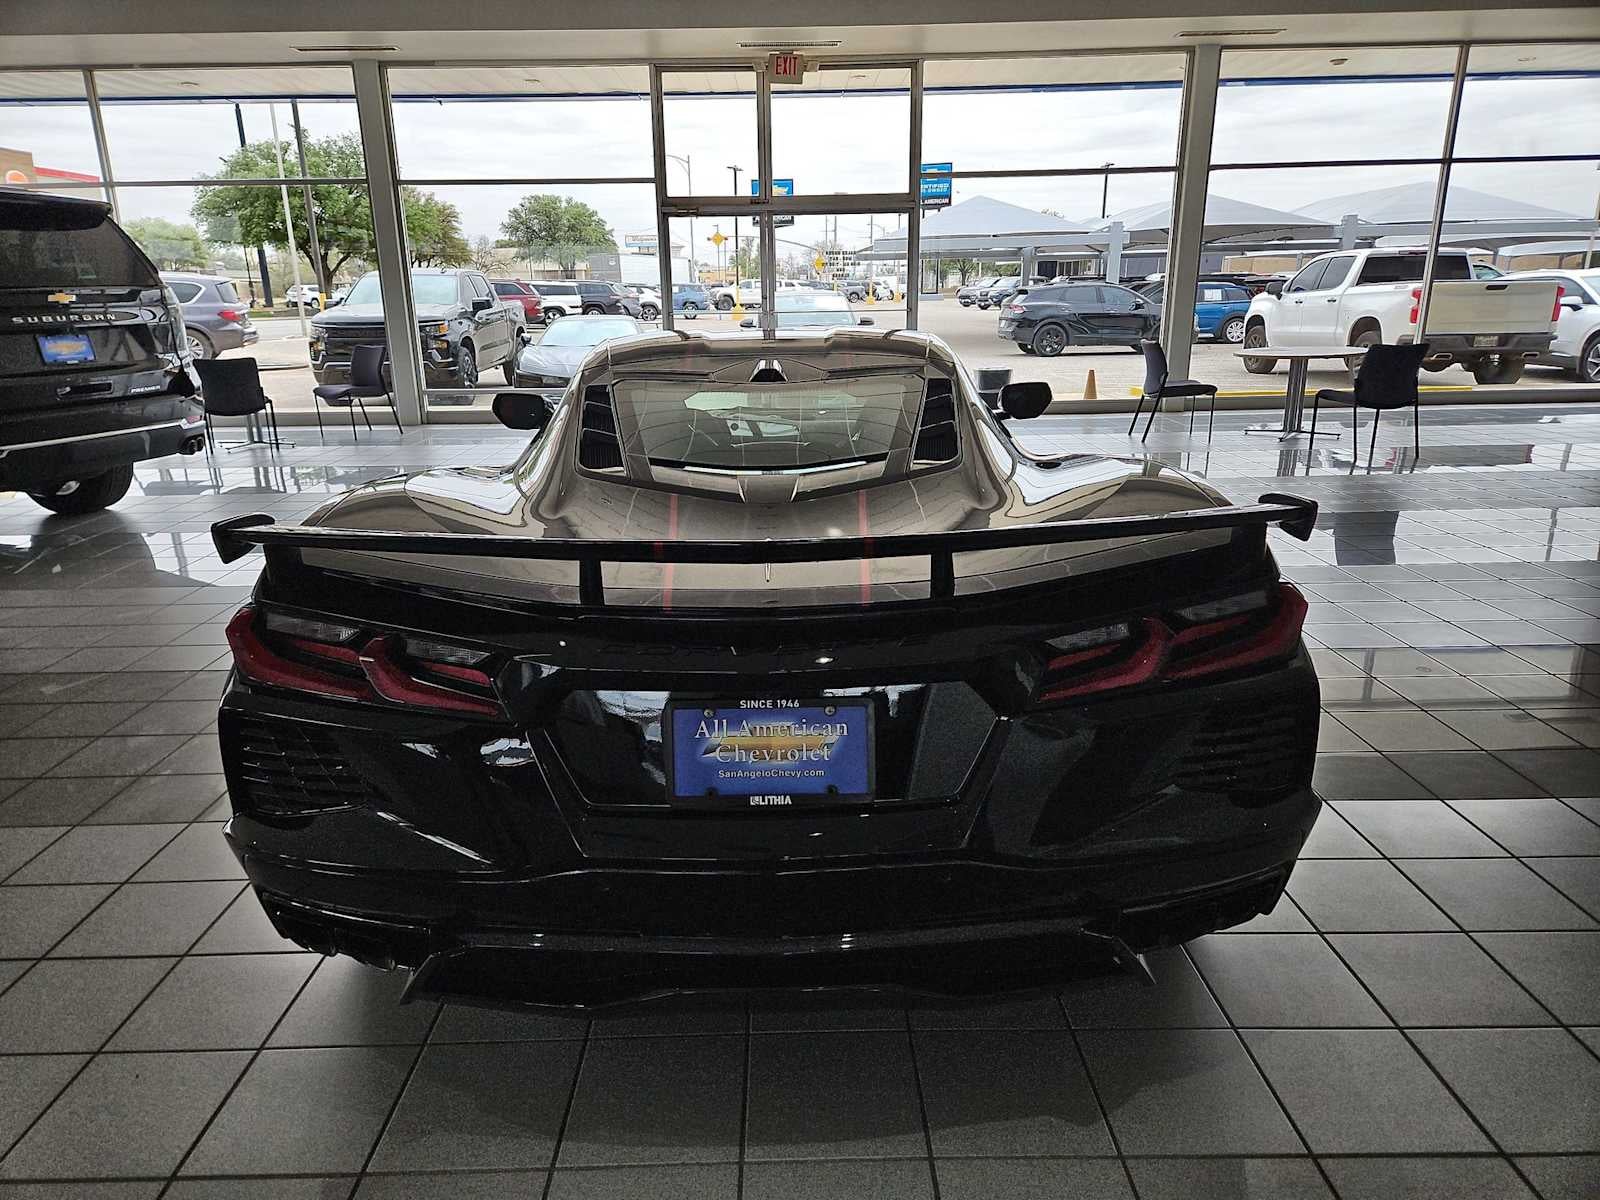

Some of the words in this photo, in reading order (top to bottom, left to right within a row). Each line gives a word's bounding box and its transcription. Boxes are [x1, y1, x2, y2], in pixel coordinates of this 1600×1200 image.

[775, 56, 798, 76] EXIT
[11, 313, 116, 324] SUBURBAN
[131, 385, 161, 393] PREMIER
[740, 700, 773, 709] SINCE
[777, 699, 800, 708] 1946
[694, 719, 729, 738] All
[738, 718, 848, 738] American
[716, 743, 831, 763] Chevrolet
[718, 769, 825, 780] SanAngeloChevy.com
[760, 795, 792, 806] LITHIA
